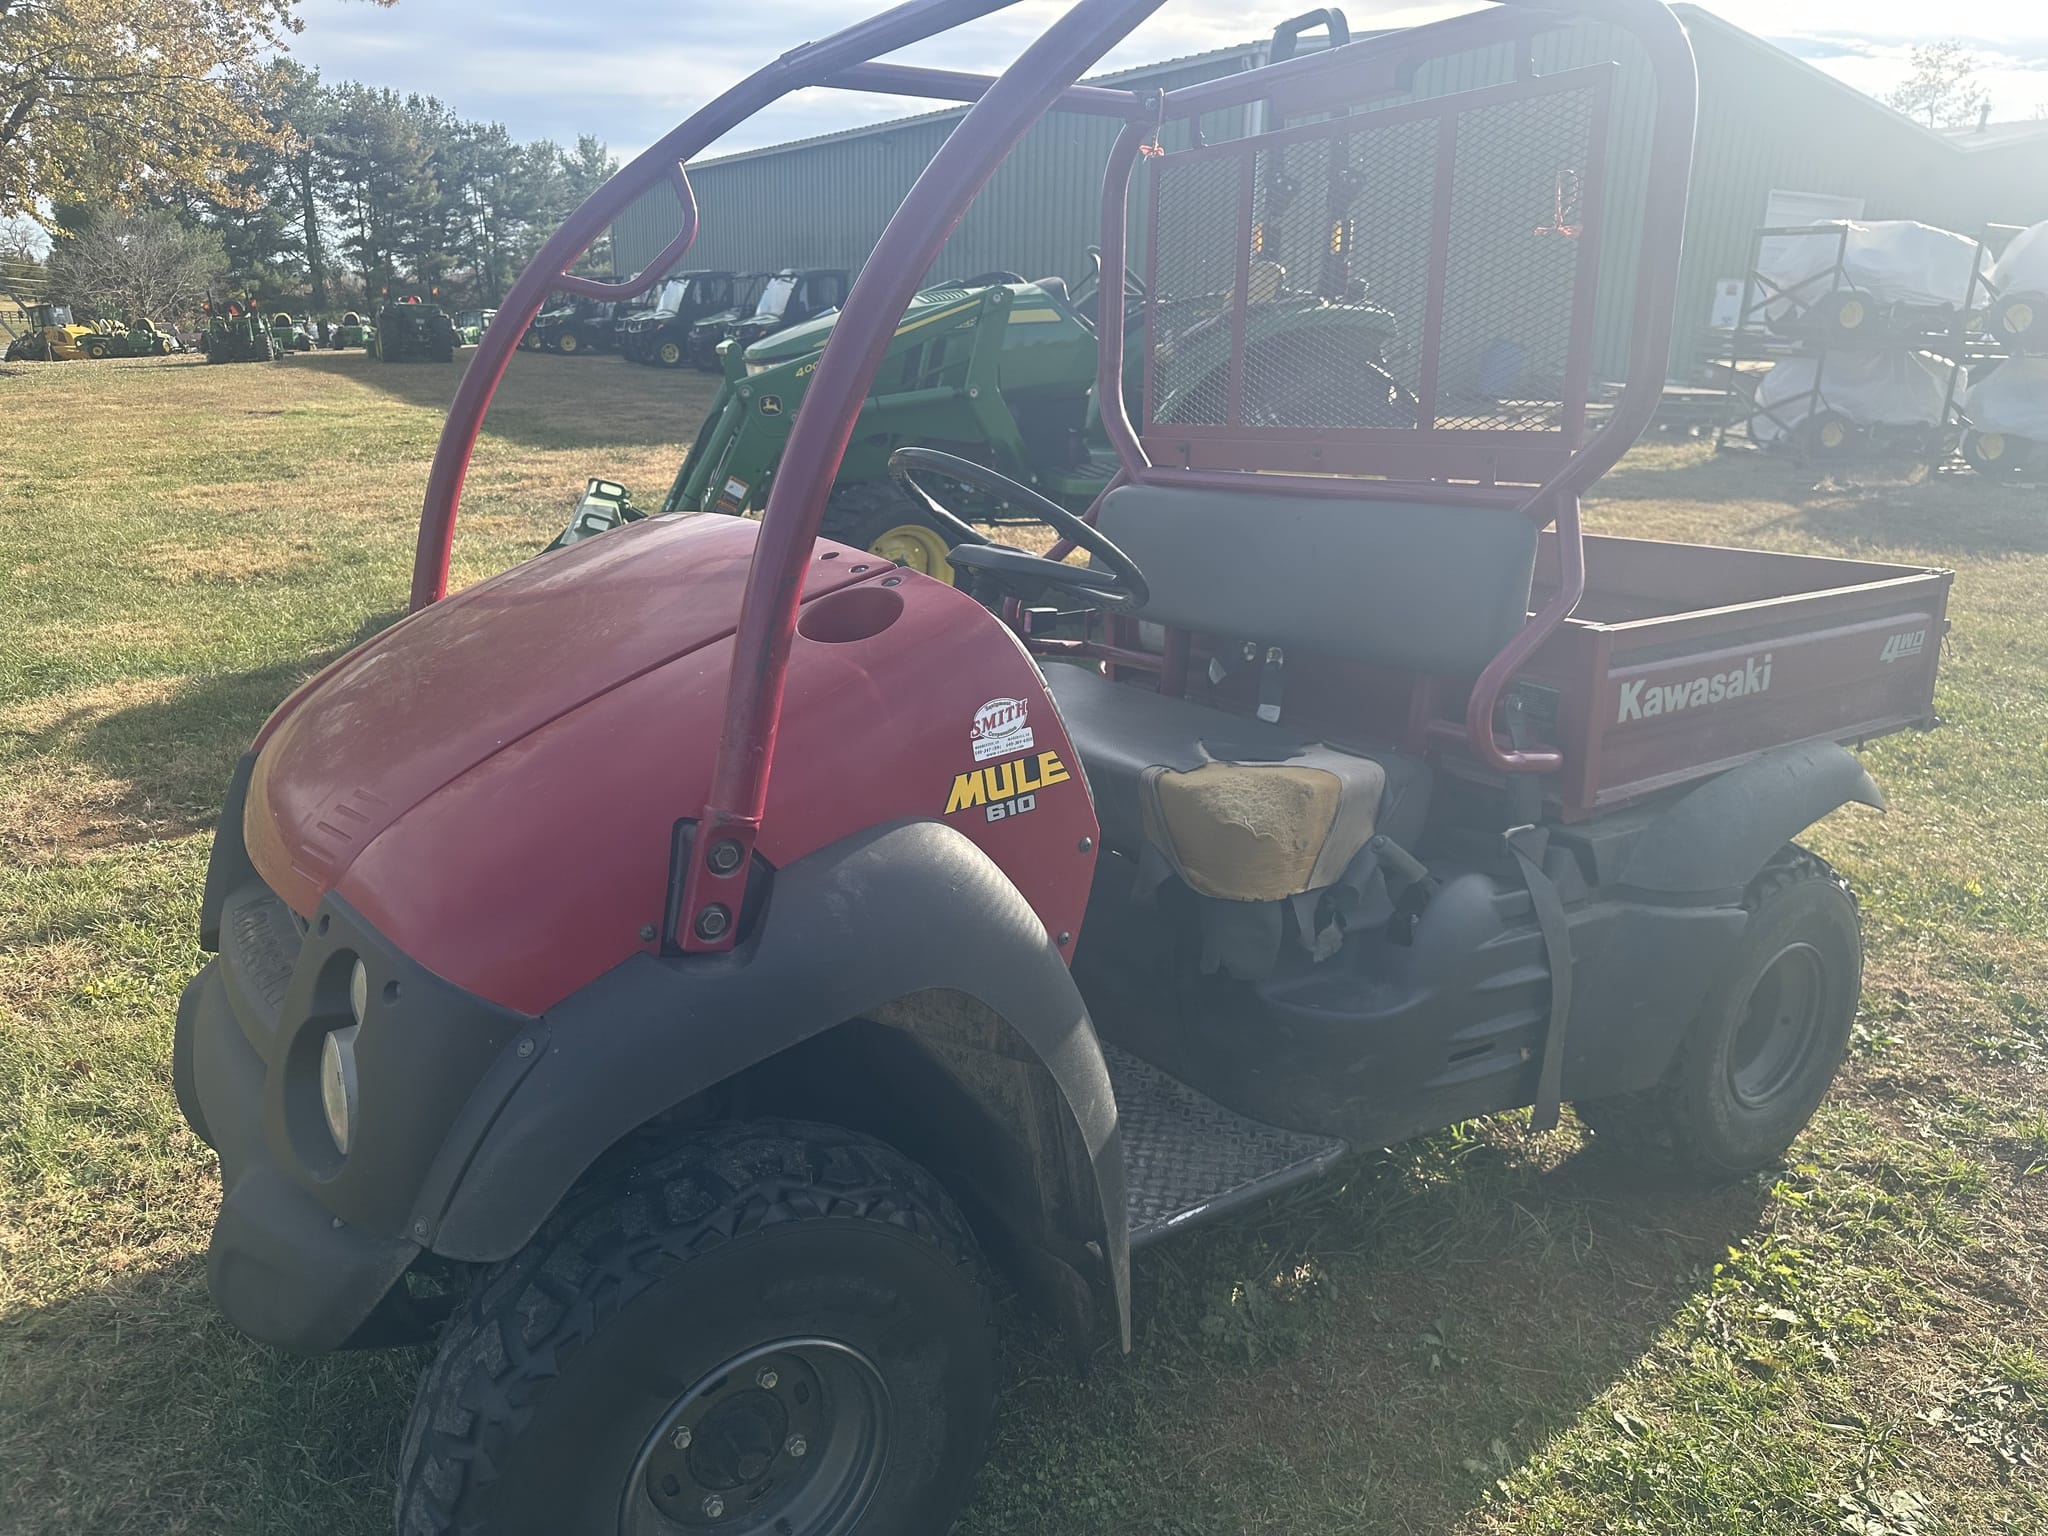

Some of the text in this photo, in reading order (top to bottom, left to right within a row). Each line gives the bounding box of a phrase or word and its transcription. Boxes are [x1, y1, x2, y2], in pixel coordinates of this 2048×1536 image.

[1880, 630, 1926, 664] 4WD
[1617, 653, 1772, 723] Kawasaki
[971, 699, 1027, 738] SMITH
[944, 751, 1070, 814] MULE
[986, 795, 1036, 822] 610
